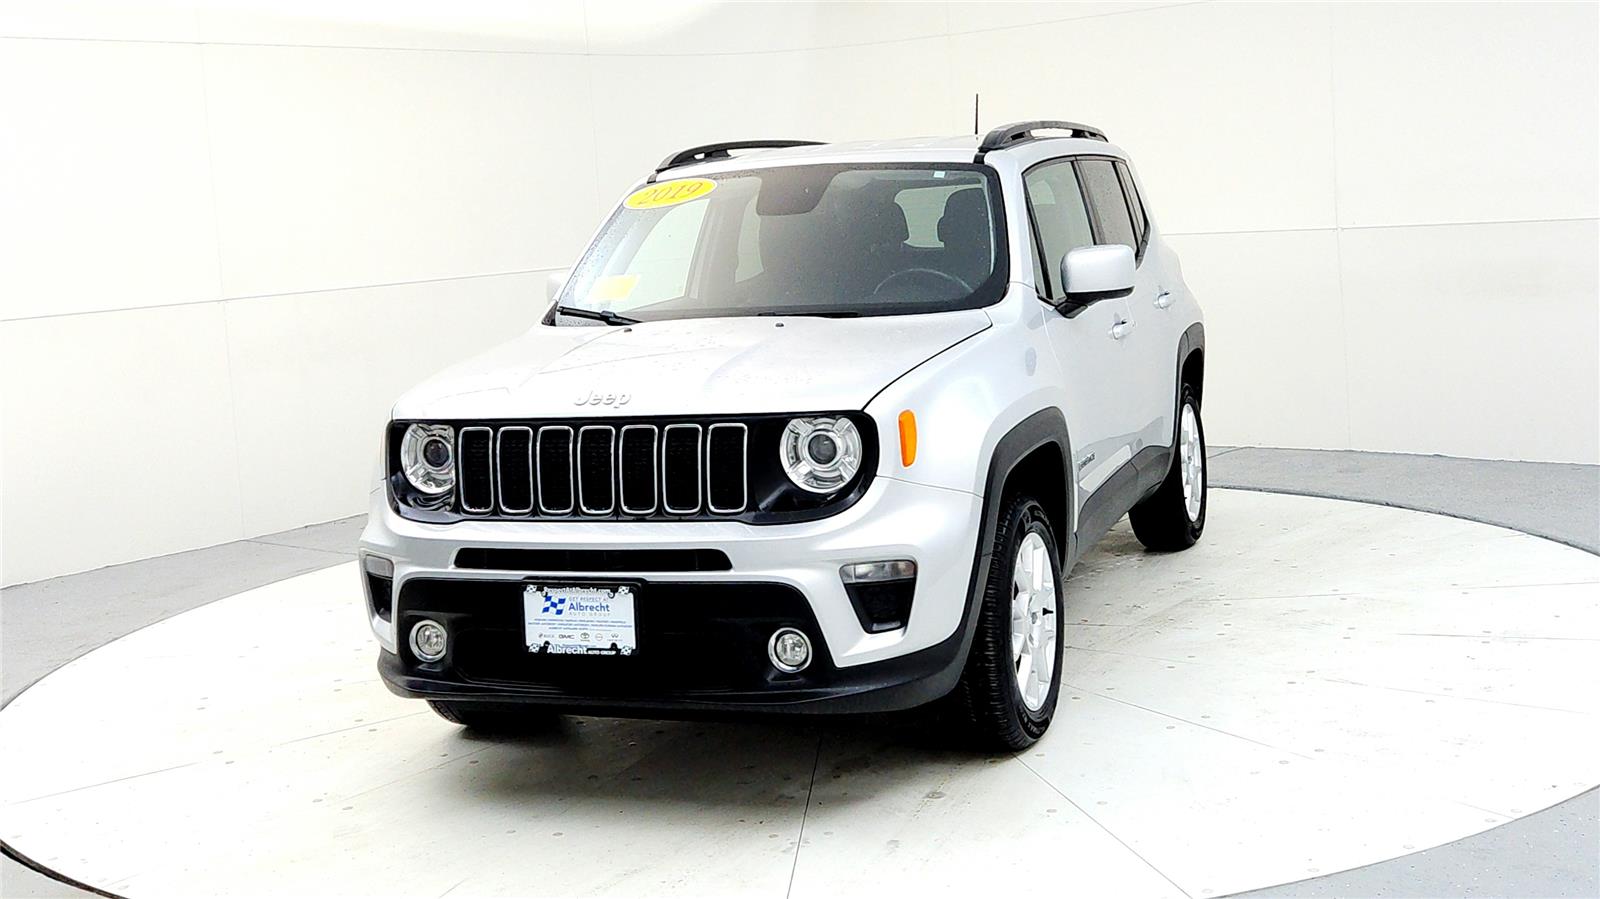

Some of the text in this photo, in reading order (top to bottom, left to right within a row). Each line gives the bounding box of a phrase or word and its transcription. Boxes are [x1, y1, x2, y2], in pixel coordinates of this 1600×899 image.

[637, 182, 704, 205] 2019
[573, 390, 632, 409] Jeep
[568, 602, 611, 613] Albrecht
[546, 643, 588, 655] Albrecht
